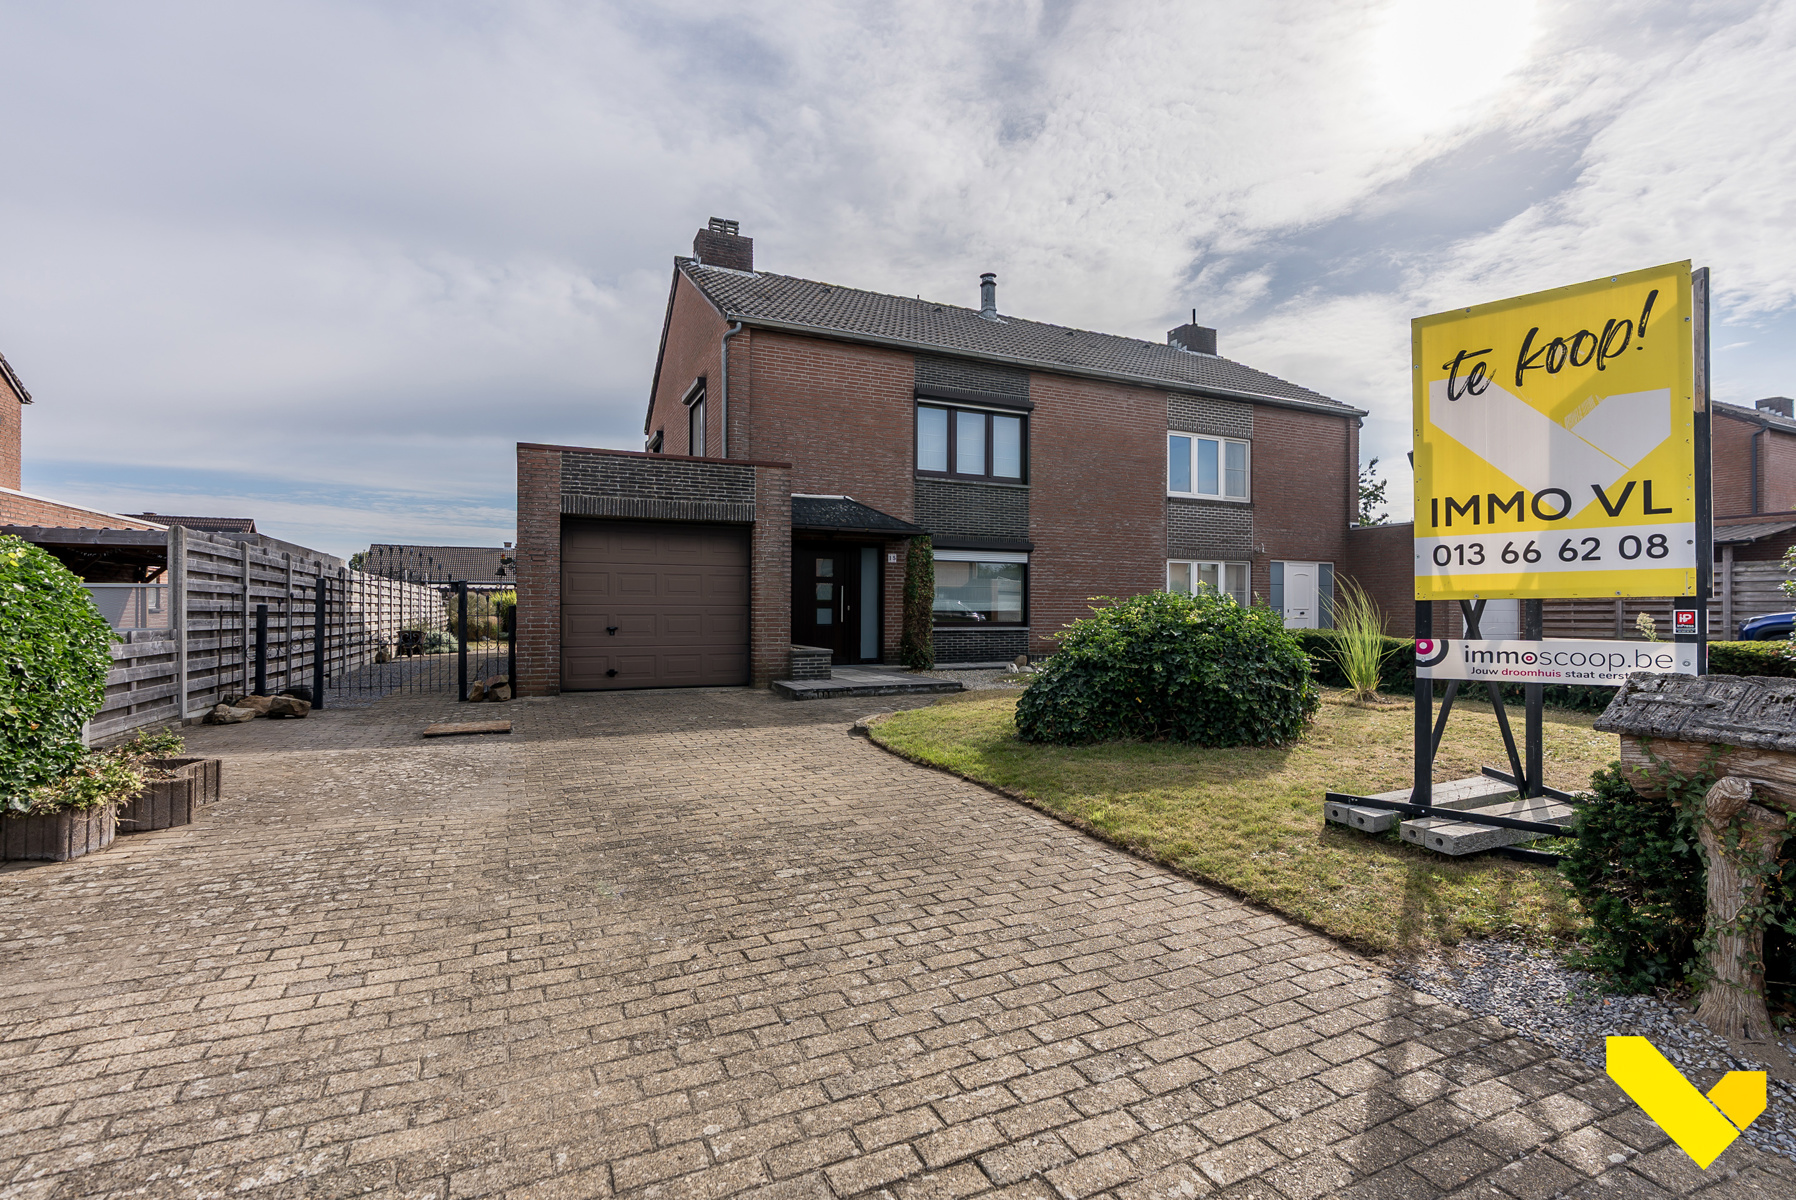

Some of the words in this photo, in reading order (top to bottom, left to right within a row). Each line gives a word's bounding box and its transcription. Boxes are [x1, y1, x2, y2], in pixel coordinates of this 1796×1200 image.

[1442, 348, 1497, 402] te
[1515, 289, 1659, 387] koop!
[1431, 487, 1572, 528] IMMO
[1590, 480, 1673, 518] VL
[1432, 542, 1486, 567] 013
[1500, 540, 1542, 565] 66
[1558, 537, 1602, 562] 62
[1618, 533, 1670, 560] 08
[1464, 645, 1674, 672] immoscoop.be
[1471, 667, 1499, 675] Jouw
[1501, 668, 1562, 678] droomhuis
[1565, 670, 1595, 679] staat
